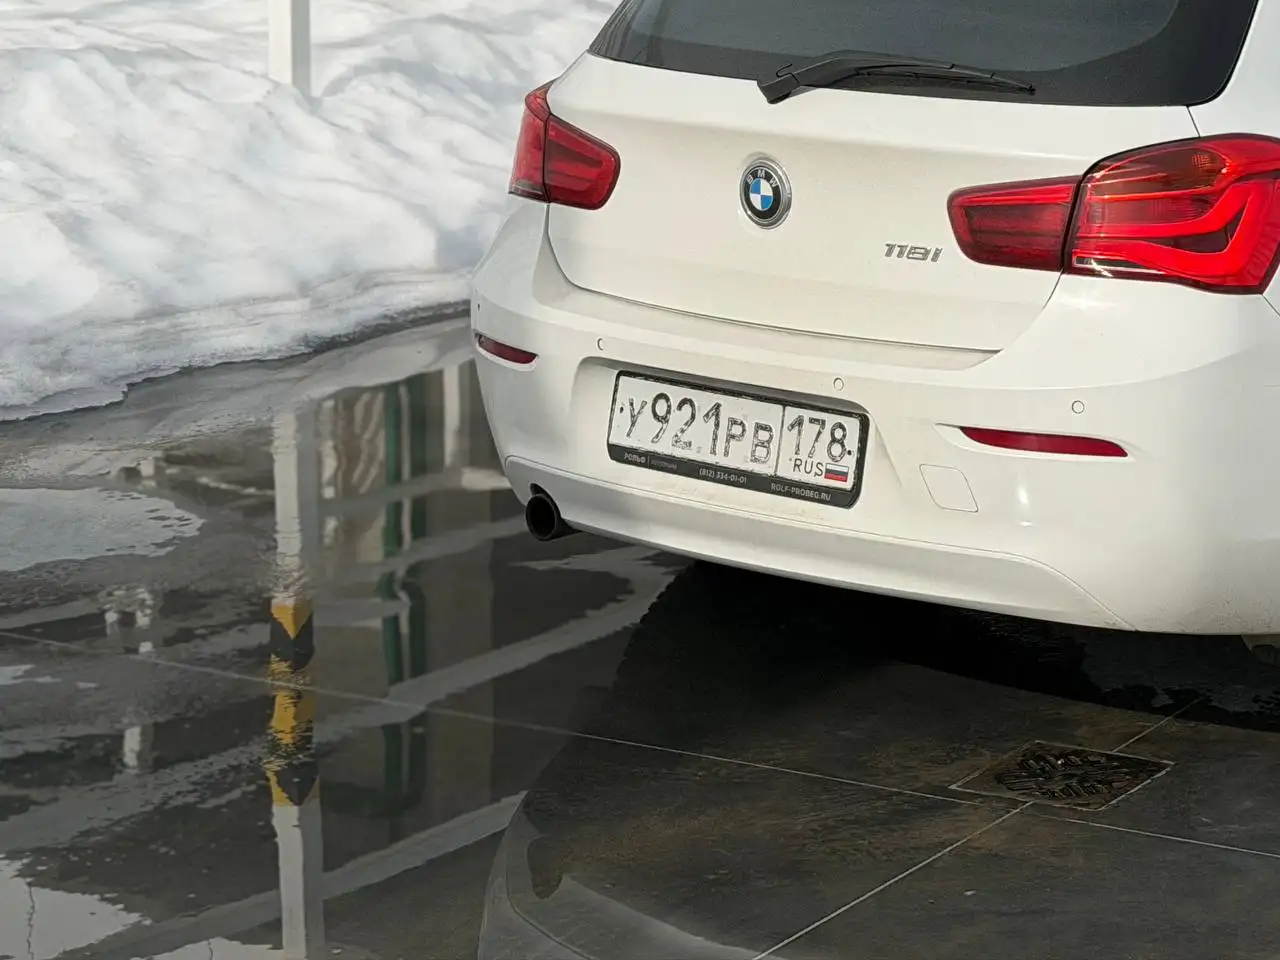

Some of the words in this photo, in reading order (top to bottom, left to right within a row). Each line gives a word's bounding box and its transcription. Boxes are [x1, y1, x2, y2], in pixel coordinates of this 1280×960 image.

[746, 169, 780, 188] BMW
[786, 414, 848, 463] 178
[792, 457, 824, 477] RUS
